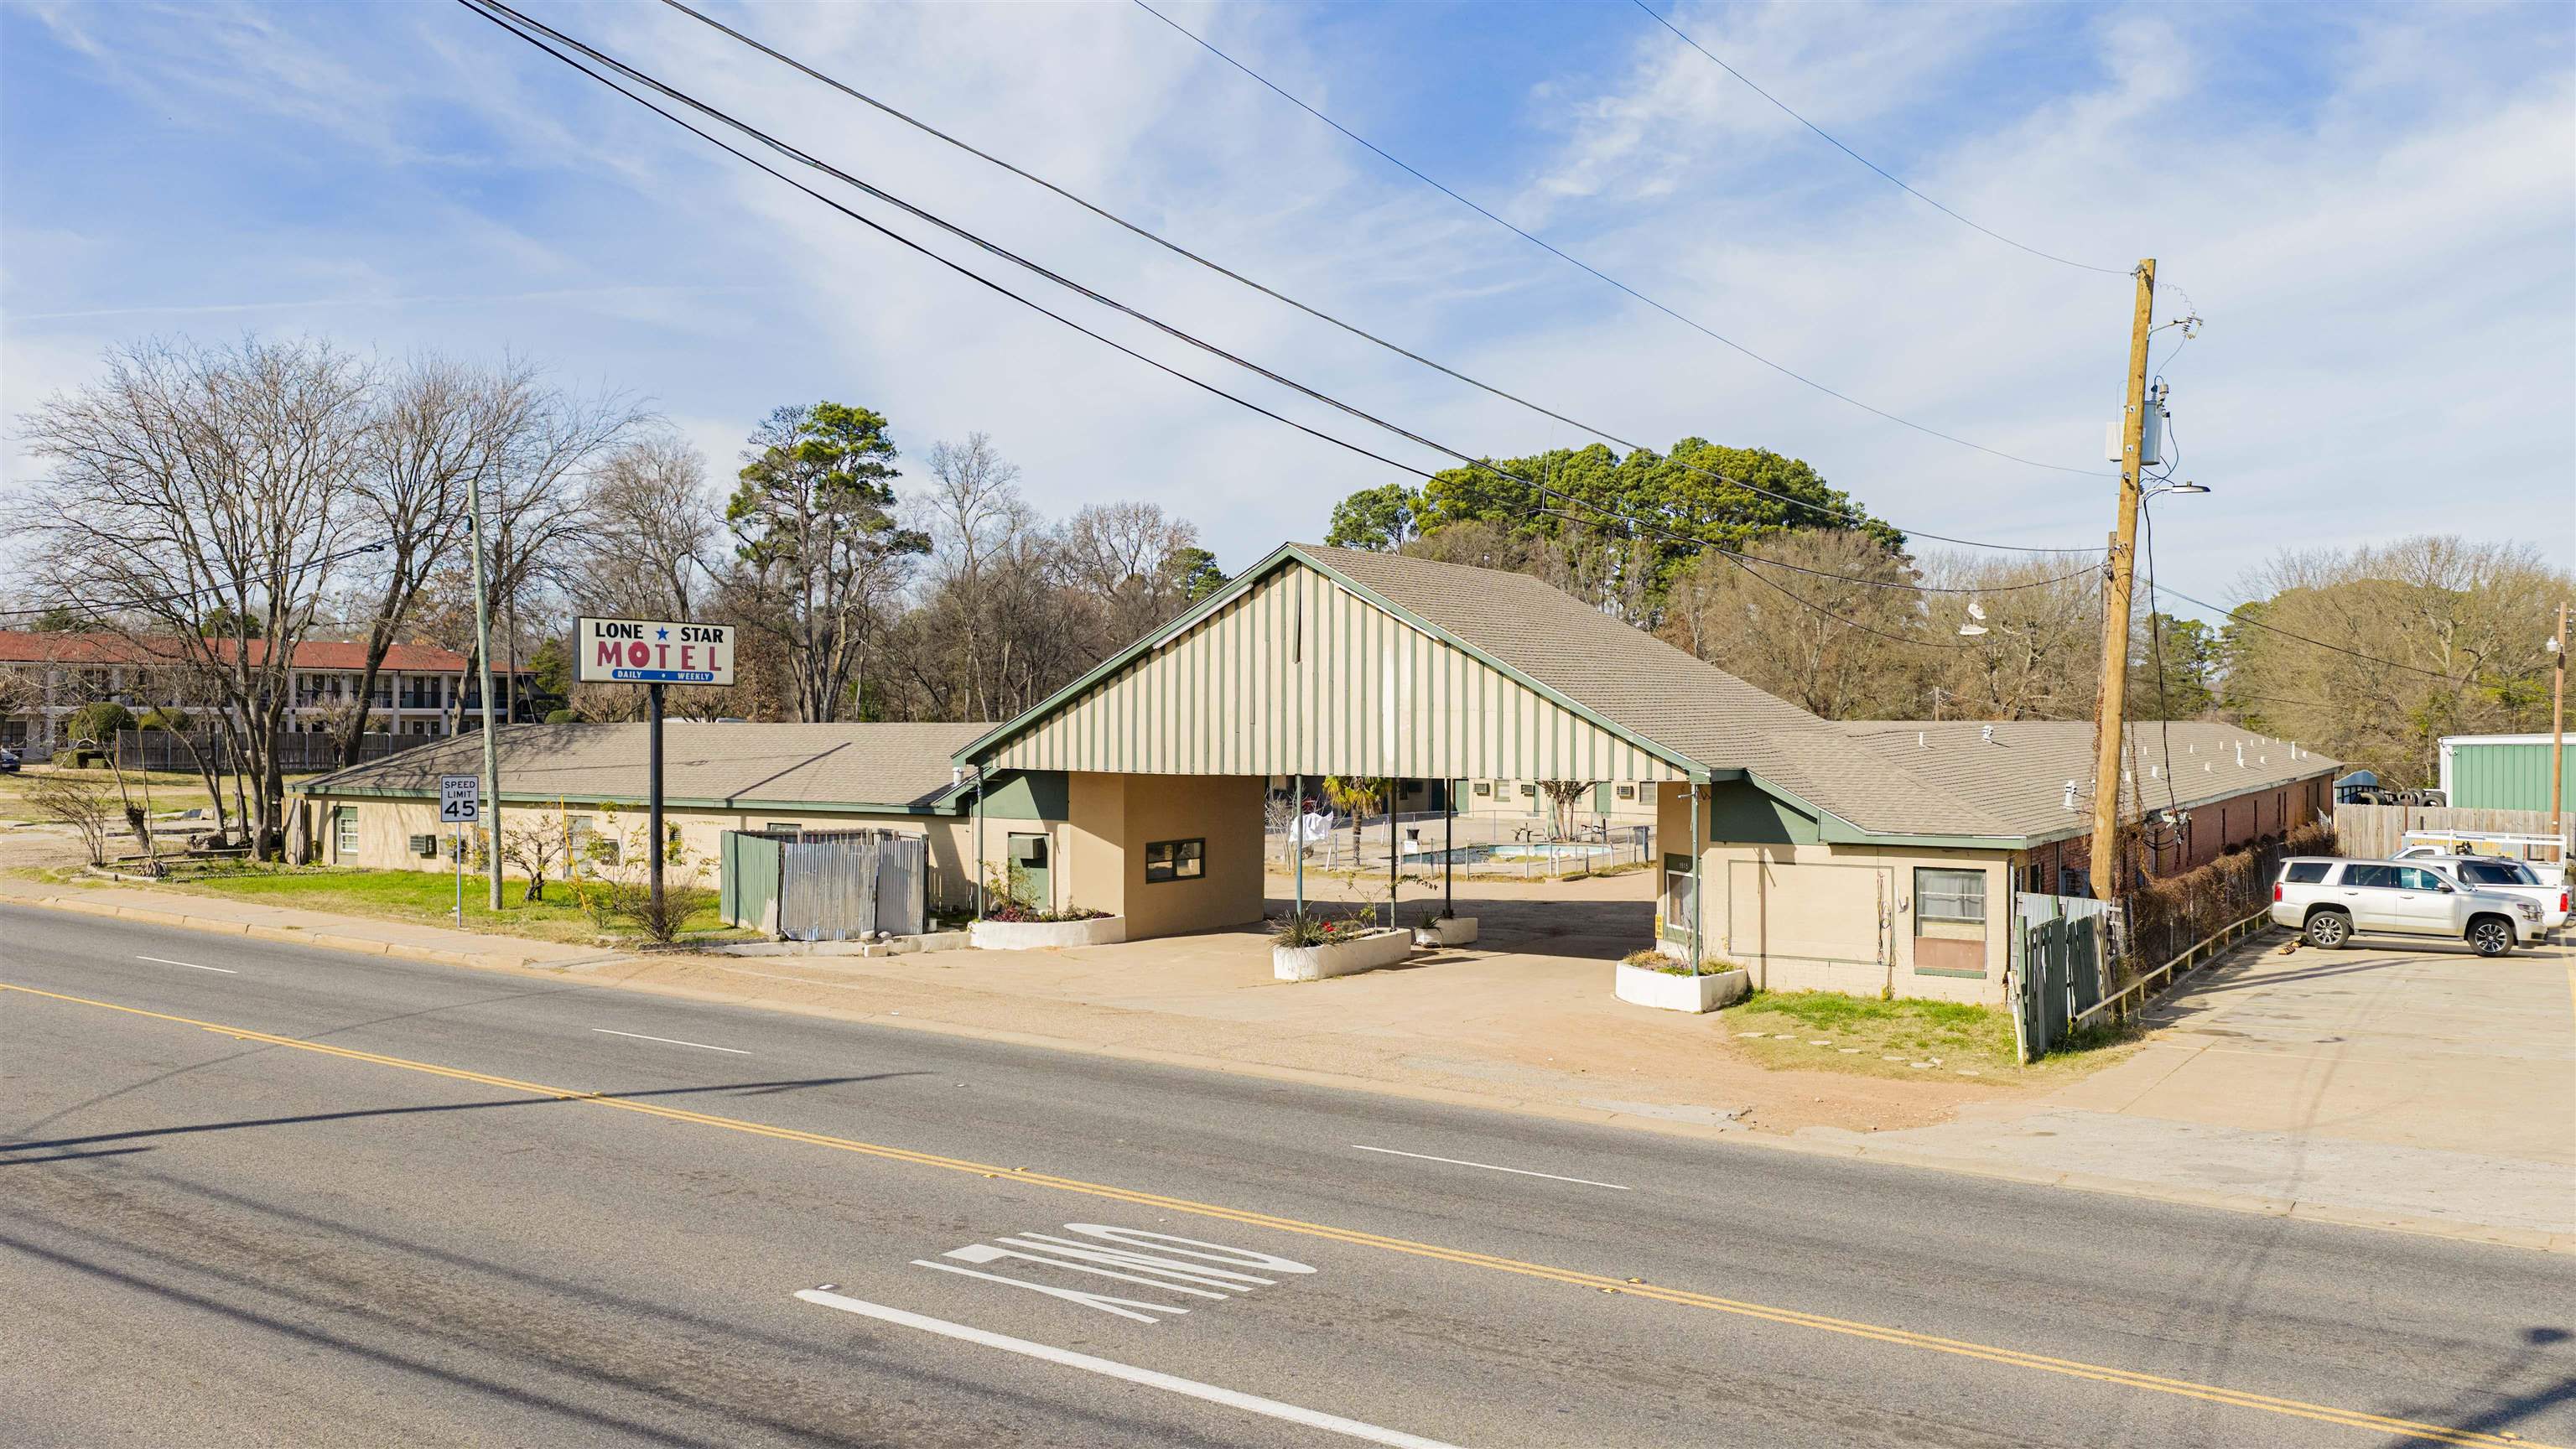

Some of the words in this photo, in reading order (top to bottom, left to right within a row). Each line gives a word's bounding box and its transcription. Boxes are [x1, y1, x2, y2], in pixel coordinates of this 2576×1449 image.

[595, 622, 644, 639] LONE
[680, 626, 724, 643] STAR
[596, 641, 722, 672] MOTEL
[617, 670, 642, 678] DAILY
[677, 673, 710, 681] WEEKLY
[444, 781, 475, 789] SPEED
[447, 790, 473, 798] LIMIT
[444, 800, 475, 818] 45
[909, 1223, 1318, 1324] ONLY
